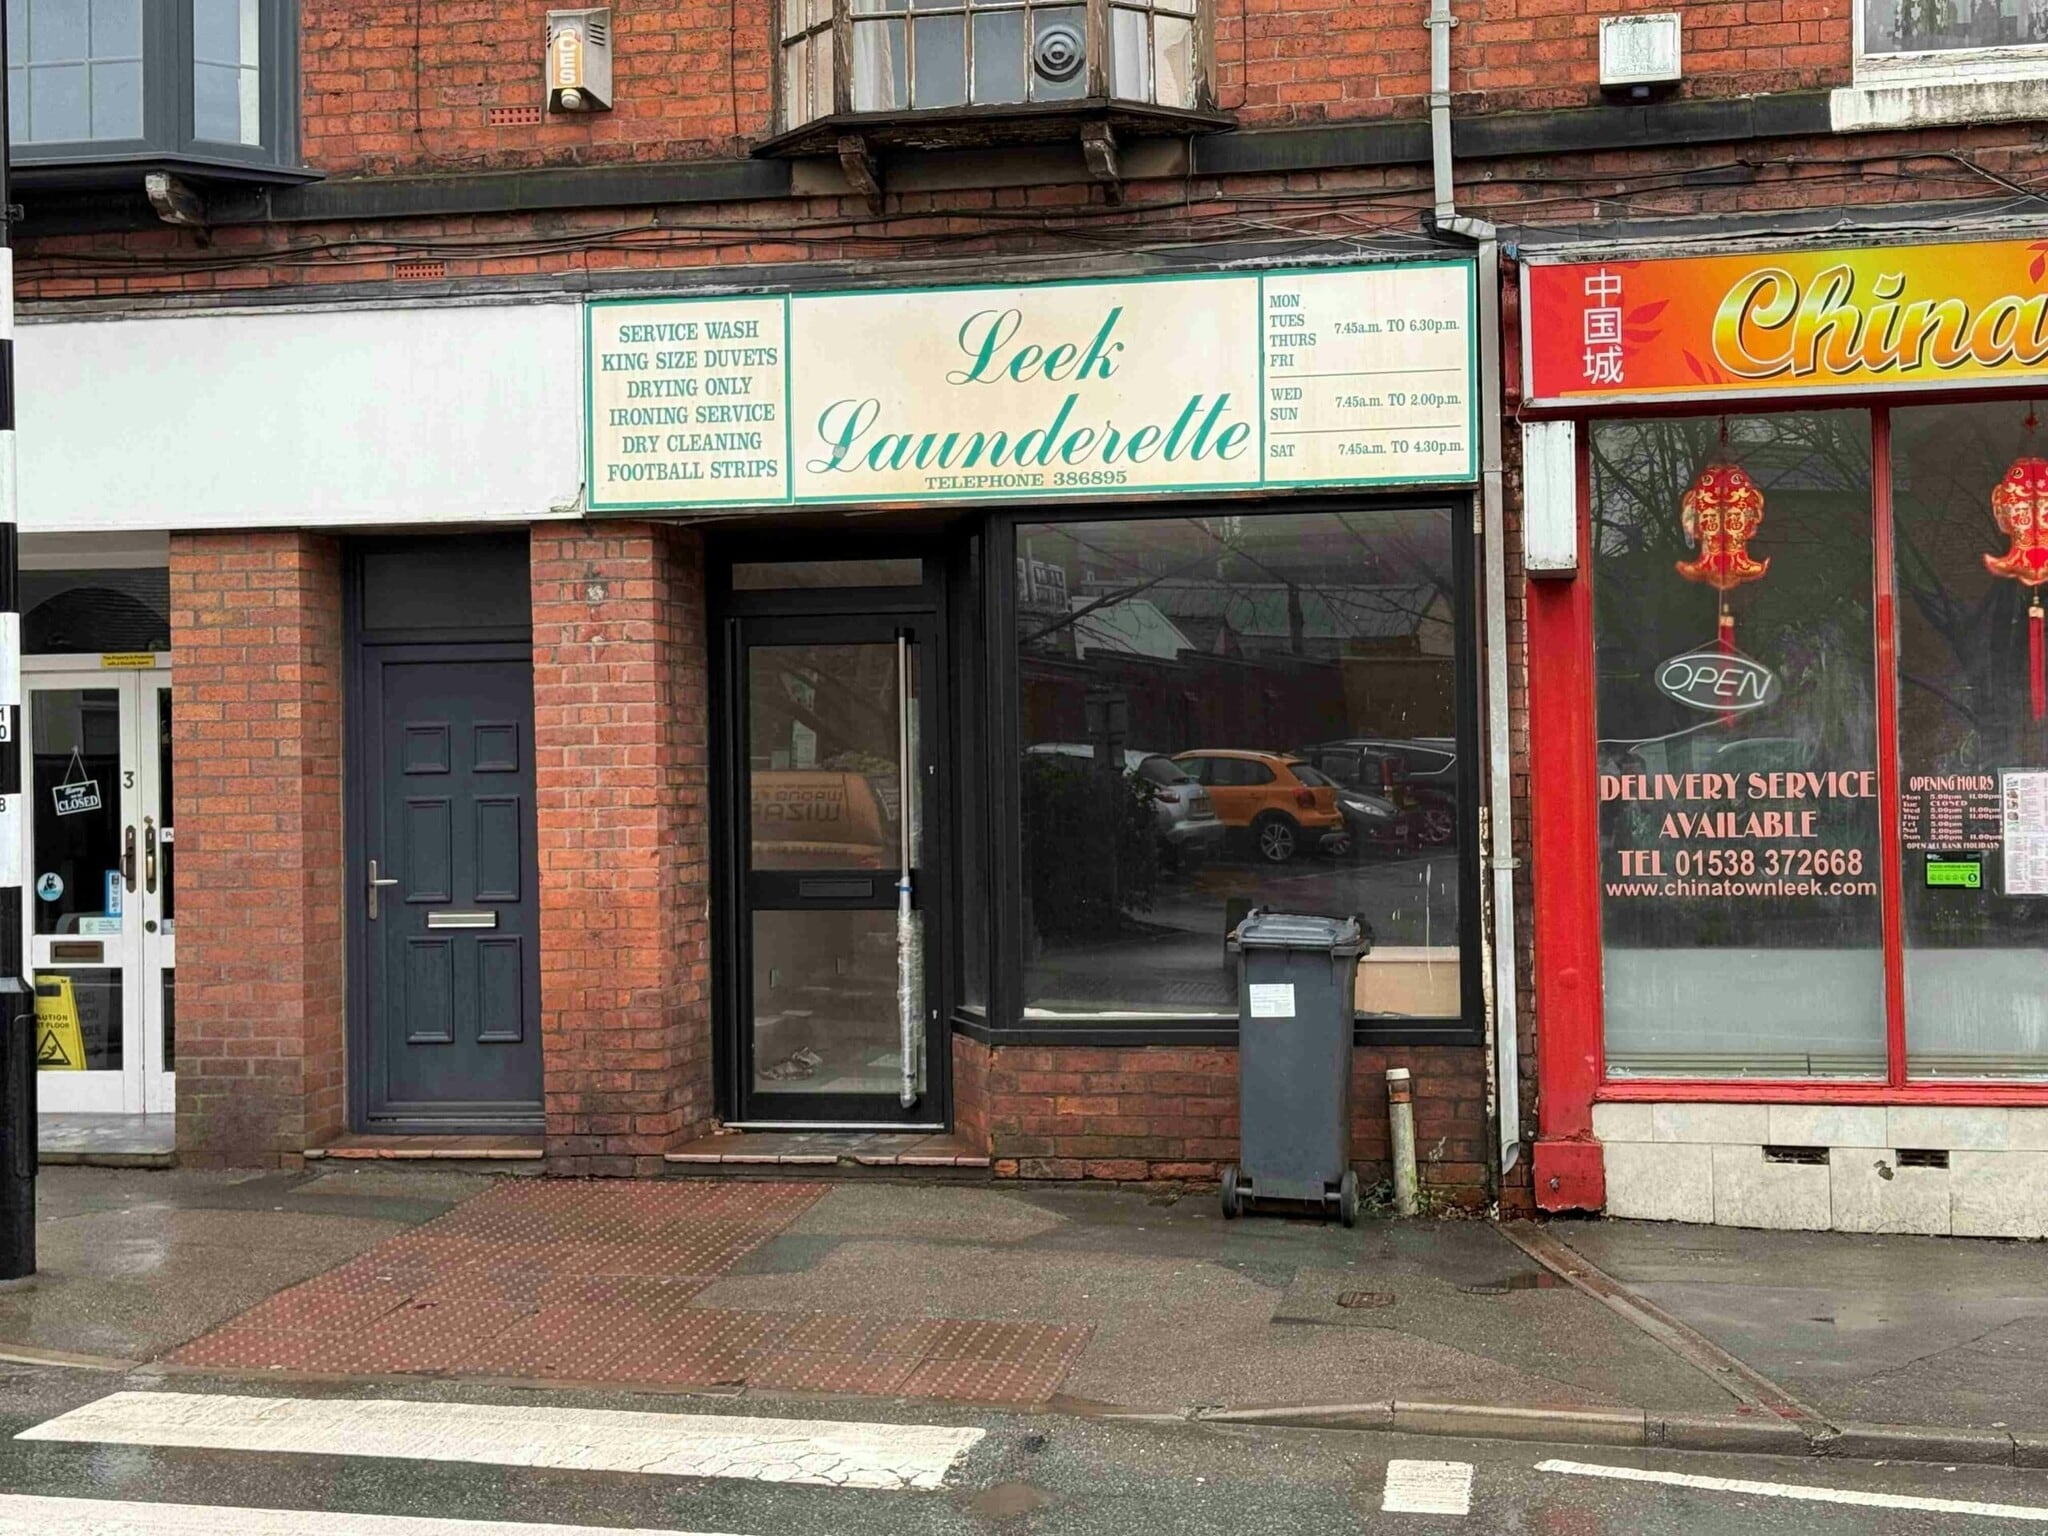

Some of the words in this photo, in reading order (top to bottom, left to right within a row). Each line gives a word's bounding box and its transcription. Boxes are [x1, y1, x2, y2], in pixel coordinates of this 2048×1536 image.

[1269, 294, 1301, 308] MON
[1269, 314, 1305, 328] TUES
[1334, 322, 1383, 335] 7.45a.m.
[1387, 319, 1405, 332] TO
[1409, 318, 1460, 334] 6.30p.m.
[1582, 268, 1624, 384] 中国城
[619, 323, 698, 343] SERVICE
[705, 320, 759, 340] WASH
[1269, 333, 1317, 347] THURS
[946, 306, 1125, 386] Leek
[601, 353, 649, 371] KING
[655, 351, 698, 369] SIZE
[704, 348, 778, 368] DUVETS
[1270, 354, 1294, 367] FRI
[627, 378, 698, 399] DRYING
[705, 377, 753, 396] ONLY
[1271, 387, 1303, 401] WED
[1335, 396, 1383, 408] 7.45a.m.
[1388, 393, 1406, 407] TO
[1410, 393, 1462, 408] 2.00p.m.
[608, 406, 688, 426] IRONING
[695, 403, 775, 424] SERVICE
[1270, 407, 1298, 421] SUN
[805, 392, 1251, 475] Launderette
[622, 435, 660, 454] DRY
[667, 432, 762, 452] CLEANING
[1270, 444, 1296, 458] SAT
[1338, 443, 1387, 456] 7.45a.m.
[1391, 440, 1409, 453] TO
[1413, 440, 1465, 455] 4.30p.m.
[607, 462, 704, 482] FOOTBALL
[710, 460, 778, 479] STRIPS
[925, 473, 1045, 489] TELEPHONE
[1053, 470, 1128, 486] 386895
[1660, 662, 1772, 700] OPEN
[123, 771, 134, 789] 3
[1600, 773, 1741, 801] DELIVERY
[1747, 771, 1877, 799] SERVICE
[1910, 776, 1955, 791] OPENING
[1957, 775, 1994, 791] HOURS
[58, 795, 98, 812] CLOSED
[1658, 811, 1818, 839] AVAILABLE
[1618, 850, 1667, 876] TEL
[1675, 850, 1755, 877] 01538
[1765, 849, 1863, 876] 372668
[1606, 879, 1877, 897] www.chinatownleek.com
